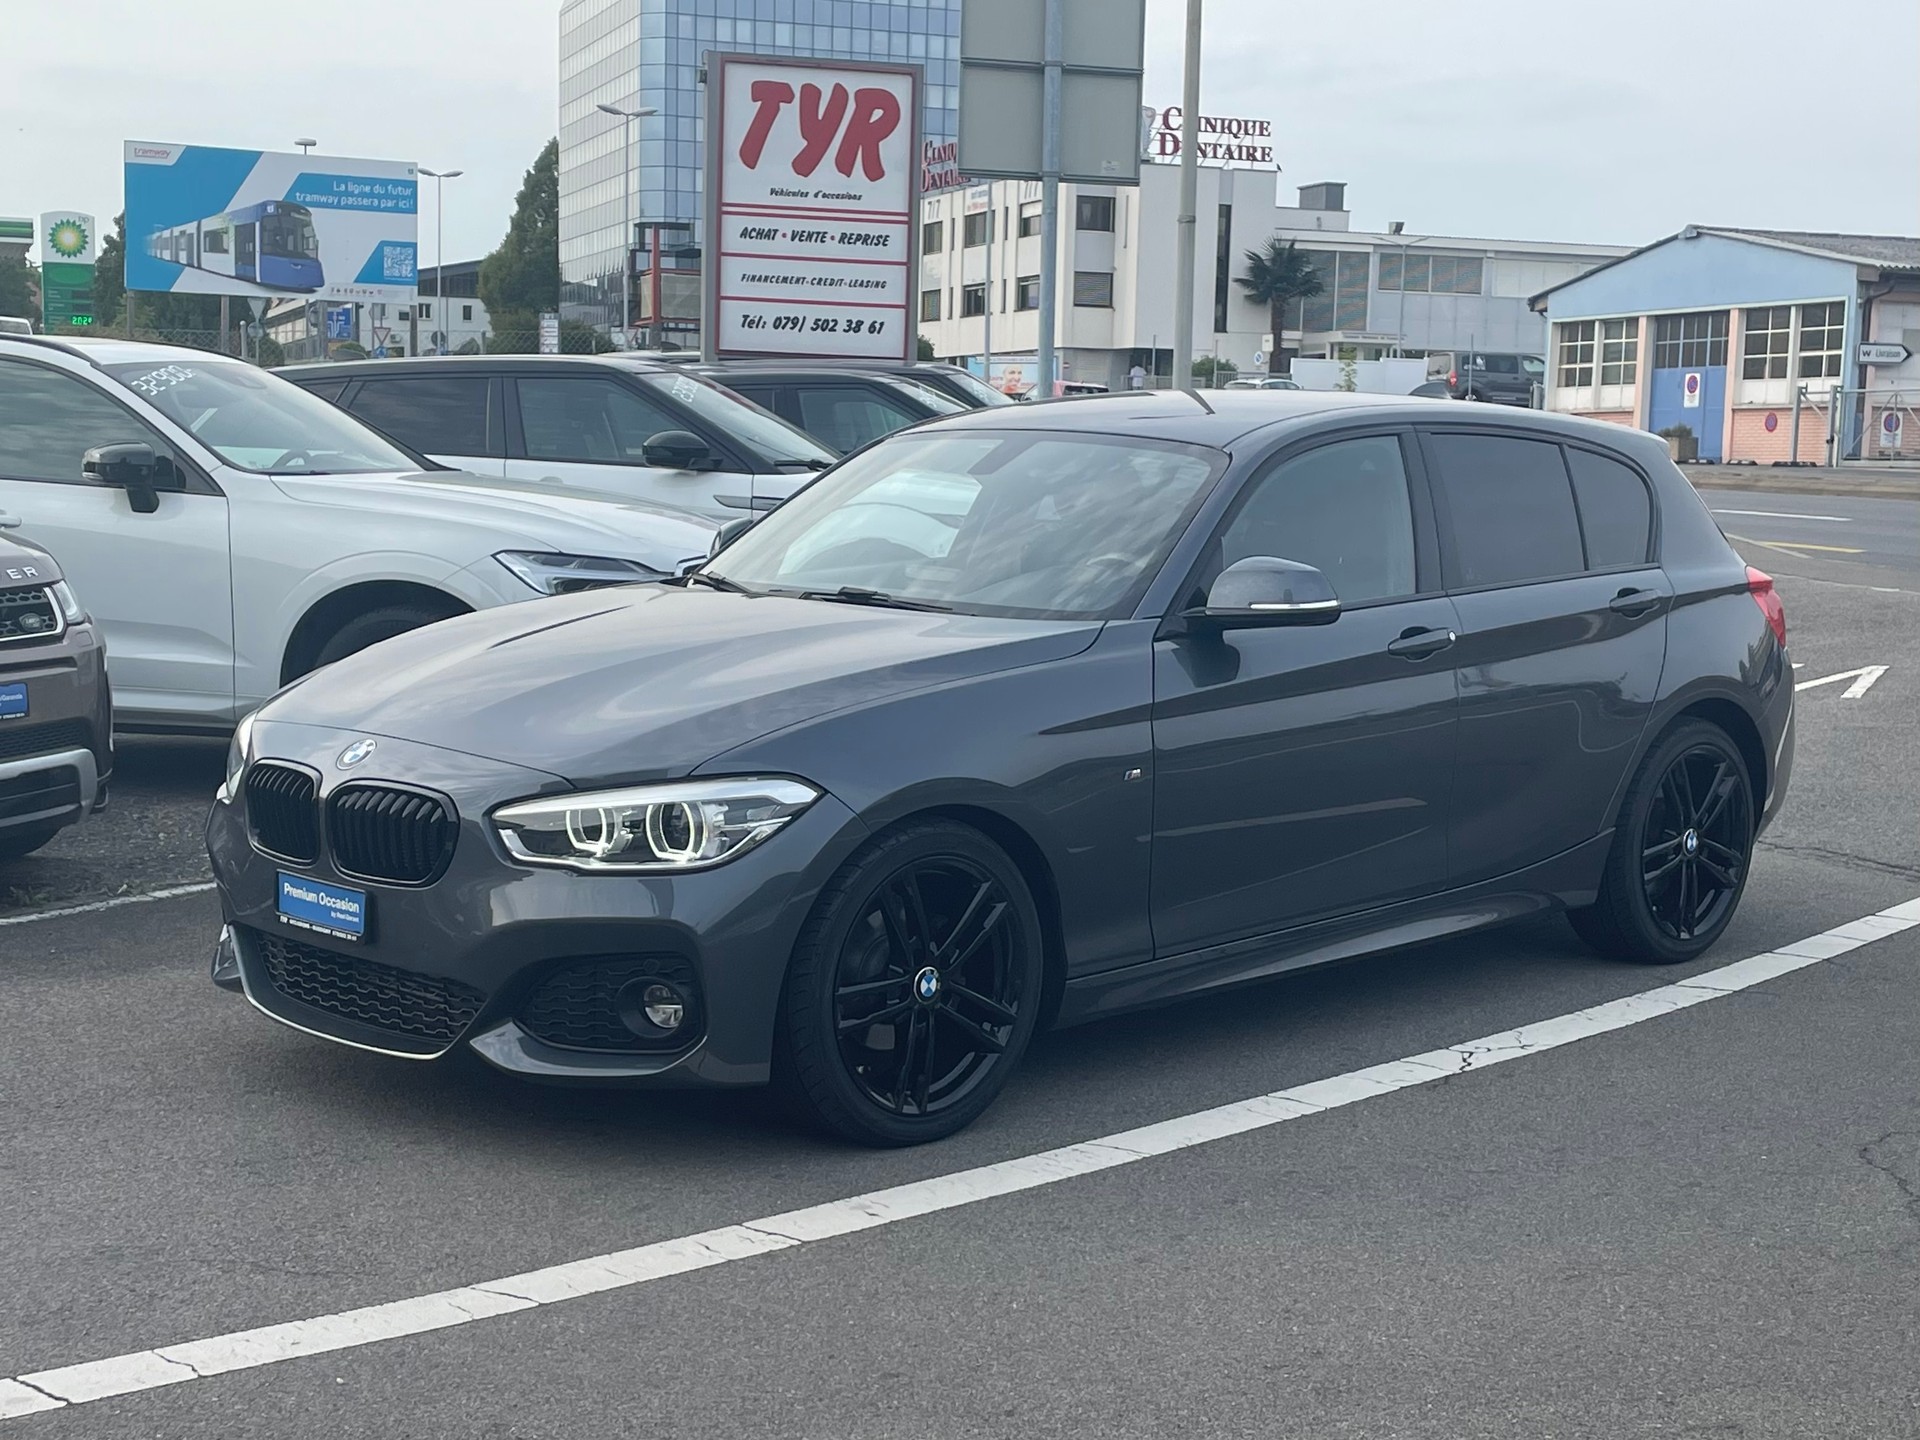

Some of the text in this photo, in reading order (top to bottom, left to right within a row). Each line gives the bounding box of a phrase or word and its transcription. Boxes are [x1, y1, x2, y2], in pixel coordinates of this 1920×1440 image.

[739, 80, 901, 182] TYR
[1162, 106, 1271, 138] CINIQUE
[922, 140, 957, 166] CLINIQ
[1157, 132, 1273, 162] DNTAIRE
[333, 180, 413, 196] La ligne du futur
[770, 187, 863, 201] Véhicules d'occasions
[295, 192, 339, 206] tramway
[341, 196, 378, 206] passera
[381, 199, 395, 208] par
[739, 226, 890, 247] ACHAT VENTE REPRISE
[741, 273, 887, 289] FINANCEMENT CREDIT LEASING
[741, 314, 767, 329] Tél:
[810, 317, 838, 332] 502
[843, 319, 864, 334] 38
[868, 320, 885, 335] 61
[284, 882, 360, 913] Premium Occasion
